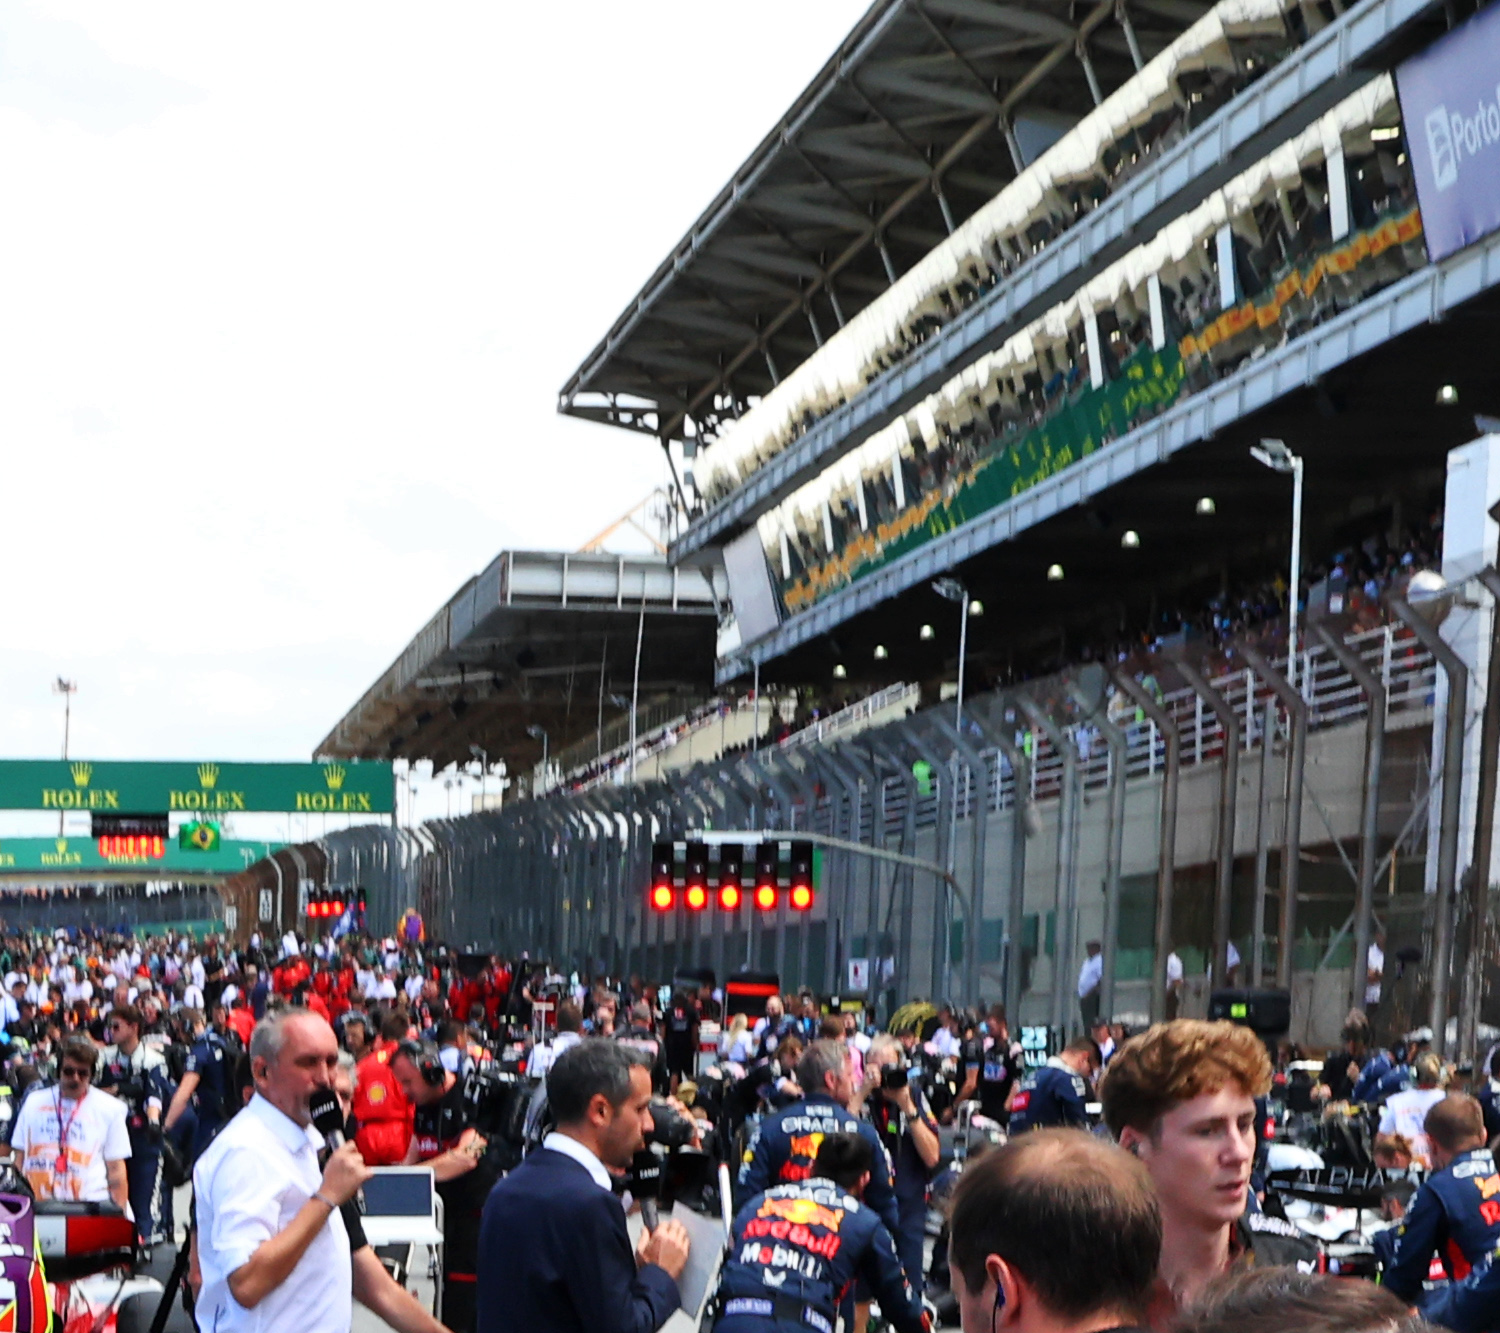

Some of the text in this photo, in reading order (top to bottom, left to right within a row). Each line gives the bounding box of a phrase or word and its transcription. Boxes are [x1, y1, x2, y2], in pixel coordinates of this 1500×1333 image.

[43, 789, 119, 809] ROLEX
[170, 790, 245, 811] ROLEX
[296, 791, 372, 812] ROLEX
